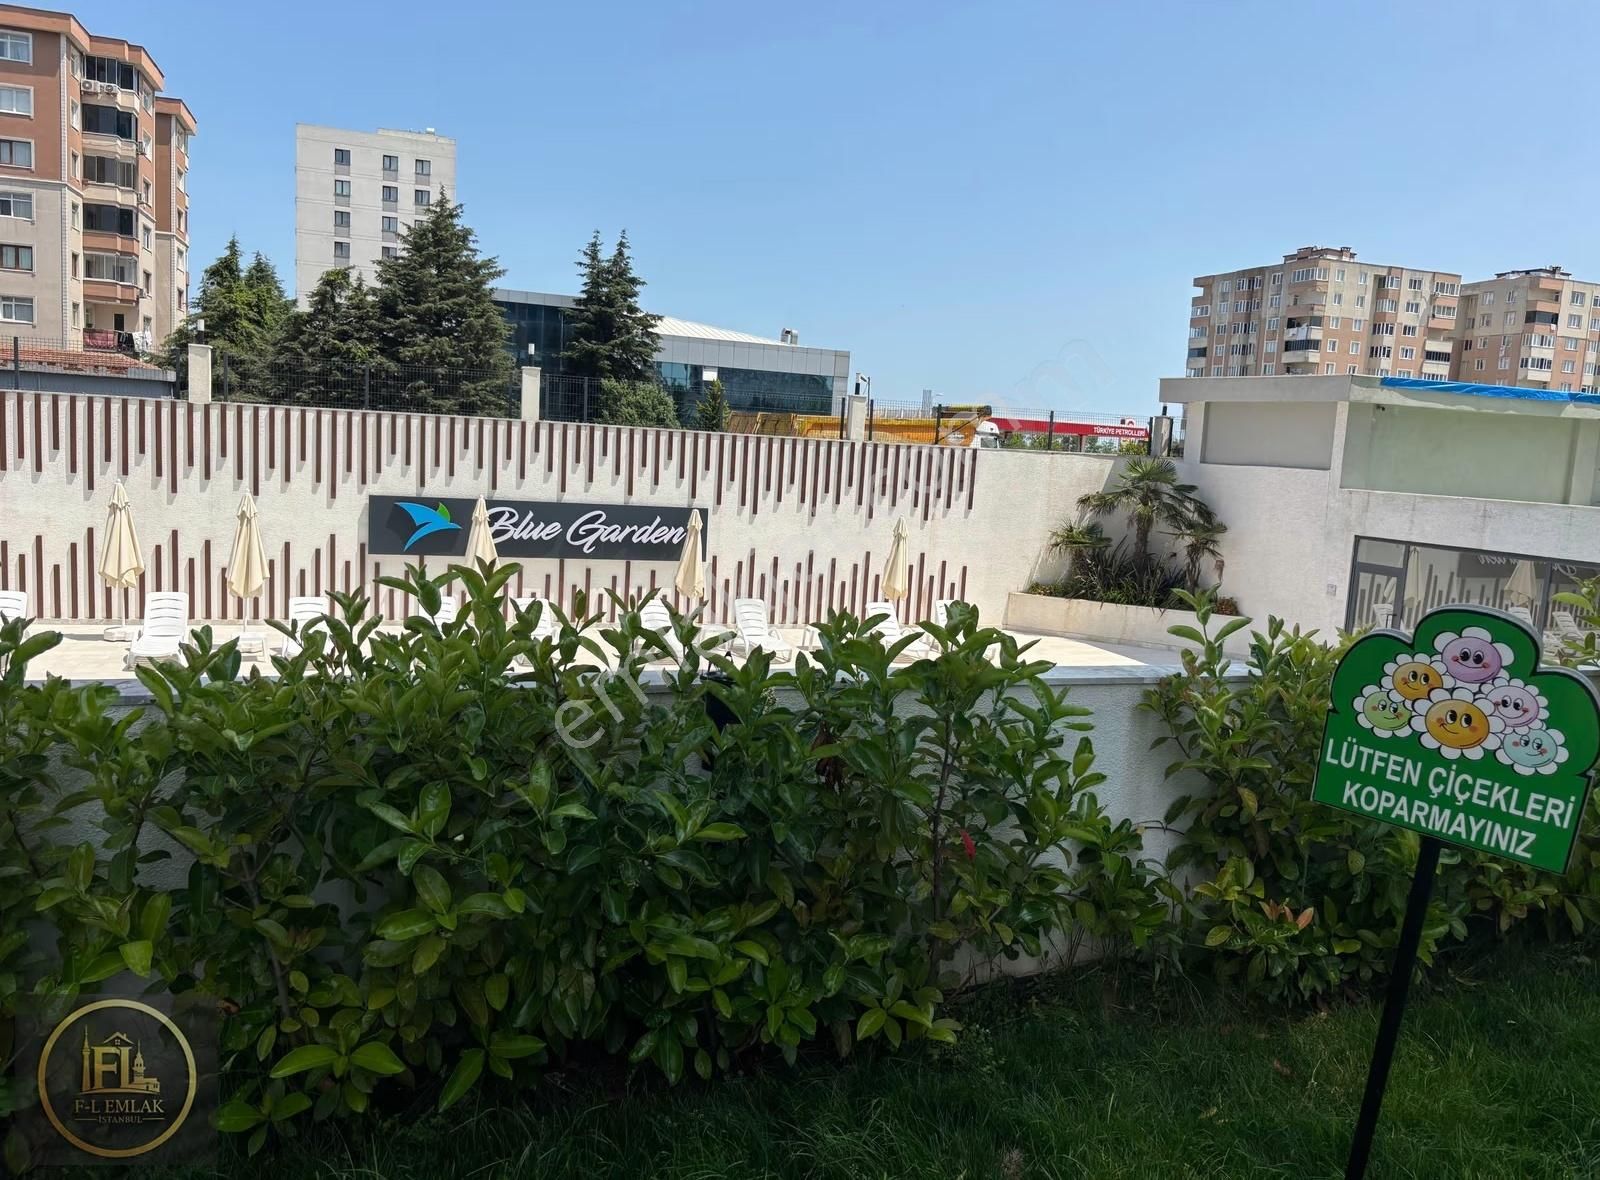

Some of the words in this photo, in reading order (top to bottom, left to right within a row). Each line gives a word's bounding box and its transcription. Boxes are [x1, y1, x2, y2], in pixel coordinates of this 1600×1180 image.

[1093, 426, 1115, 434] TÜRKİYE
[1115, 428, 1146, 437] PETROLLERİ
[486, 506, 562, 545] Blue
[565, 509, 687, 554] Garden
[1325, 736, 1422, 787] LÜTFEN
[1428, 763, 1576, 829] ÇİÇEKLERİ
[1342, 780, 1537, 859] KOPARMAYINIZ
